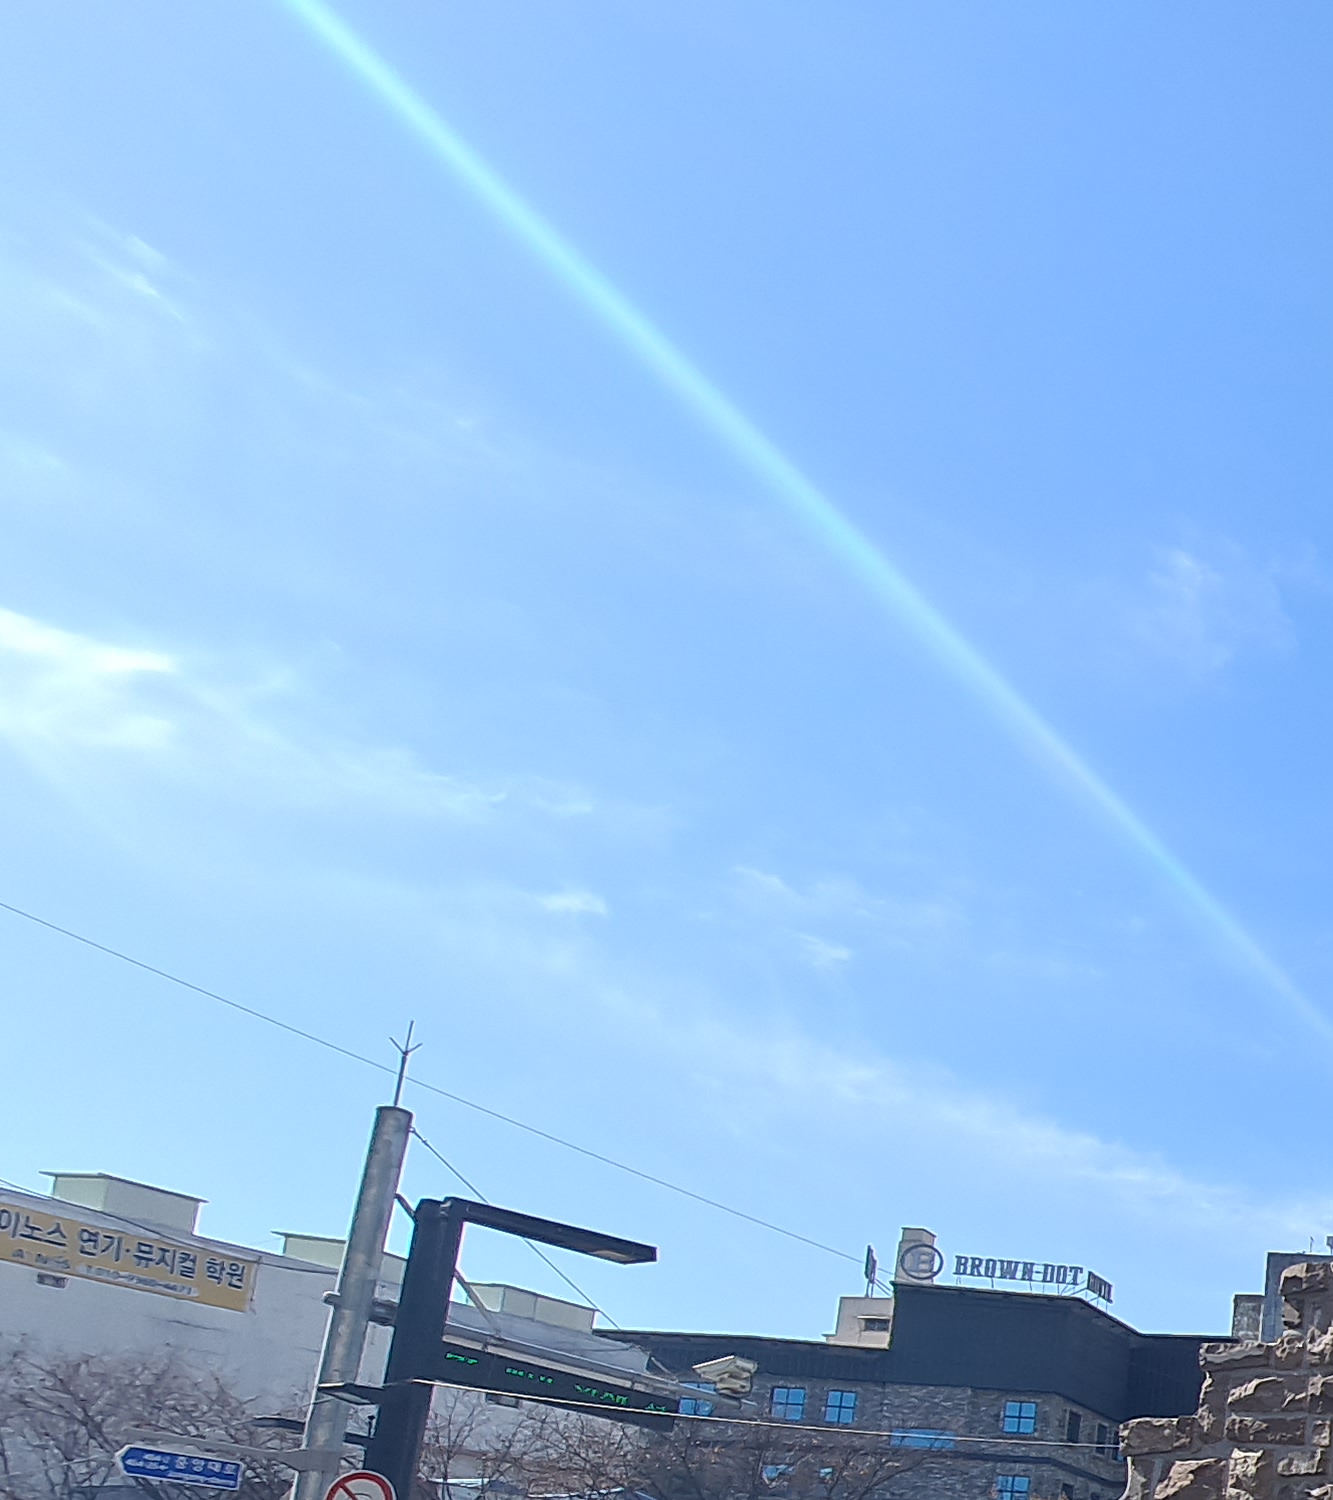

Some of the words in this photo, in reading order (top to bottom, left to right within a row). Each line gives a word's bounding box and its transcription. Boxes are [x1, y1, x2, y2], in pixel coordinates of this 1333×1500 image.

[78, 1228, 199, 1280] 연기·뮤지컬
[205, 1256, 247, 1289] 학원
[953, 1255, 1083, 1286] BROWN-DOT
